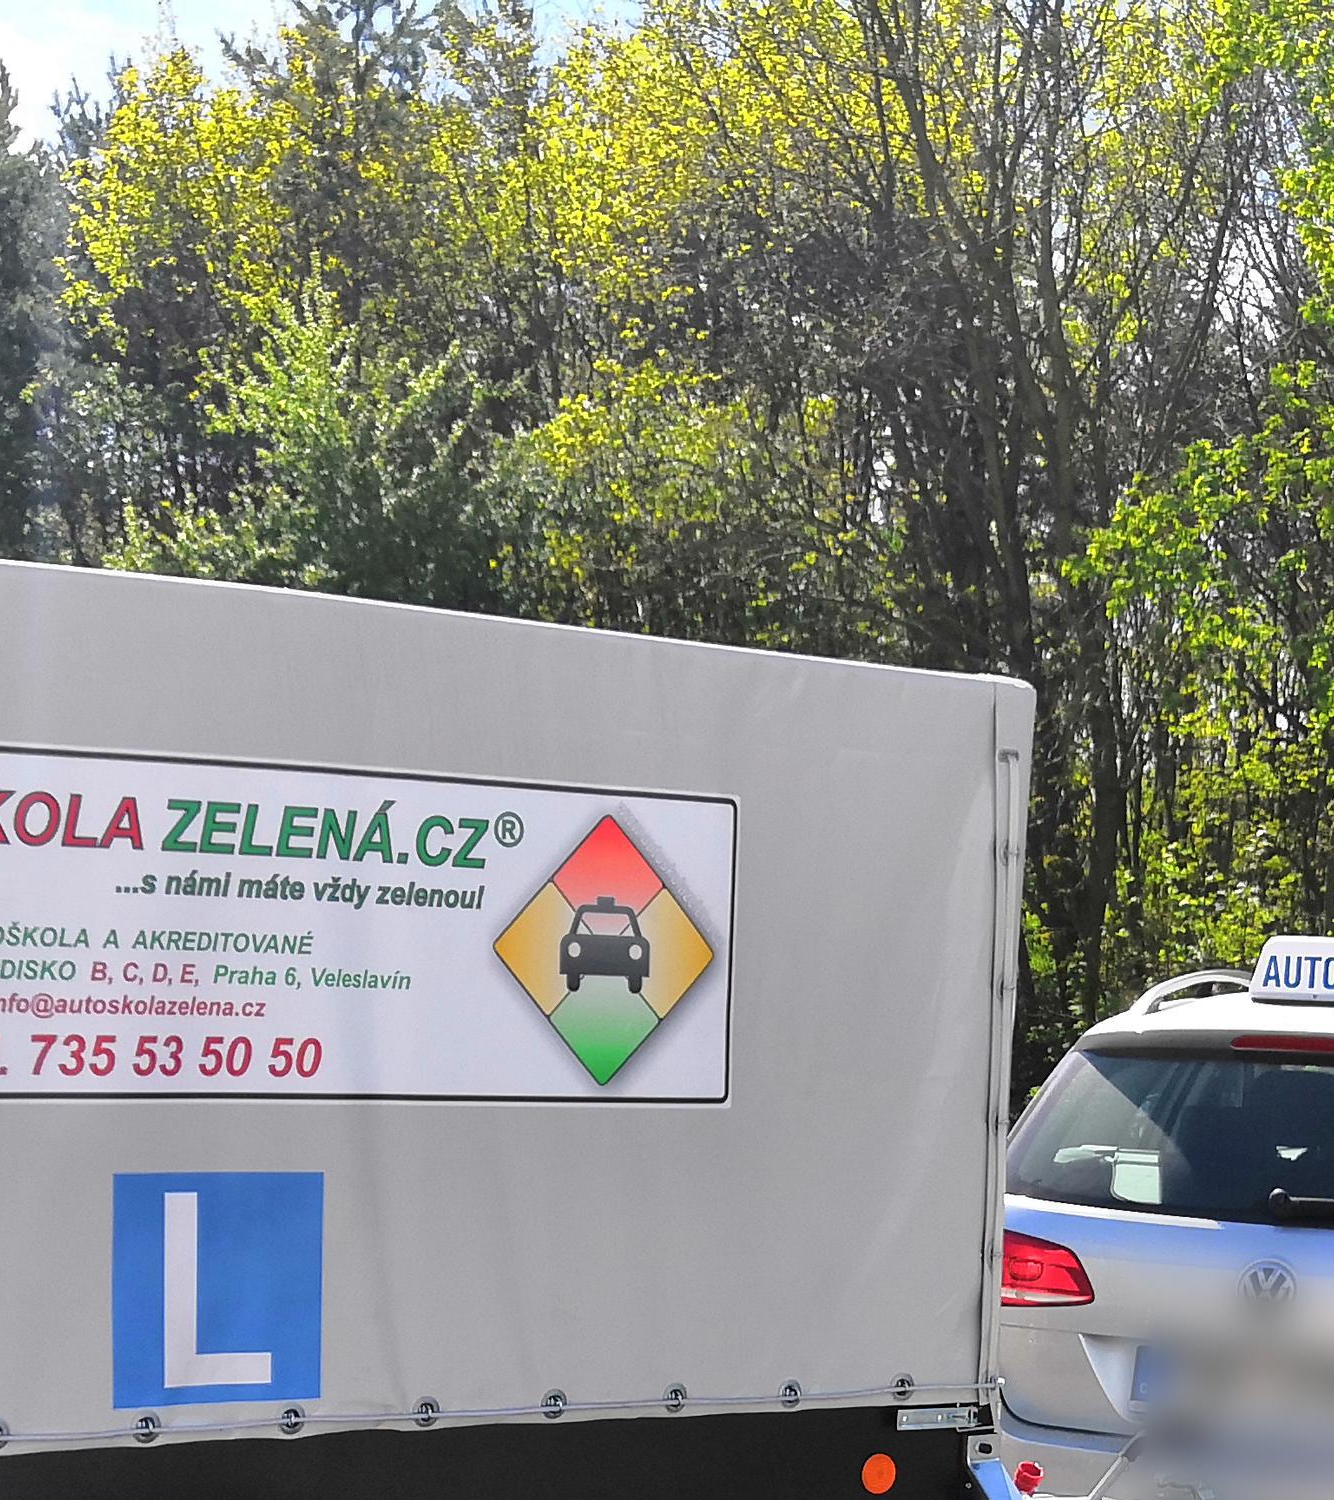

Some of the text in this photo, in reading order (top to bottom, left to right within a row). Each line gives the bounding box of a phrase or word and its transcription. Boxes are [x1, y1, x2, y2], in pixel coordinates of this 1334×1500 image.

[165, 870, 231, 898] námi
[238, 873, 305, 900] máte
[313, 876, 370, 909] vždy
[102, 928, 120, 949] A
[132, 930, 315, 955] AKREDITOVANÉ
[91, 961, 113, 985] B,
[123, 962, 144, 986] C,
[152, 963, 173, 986] D,
[180, 964, 200, 987] E,
[213, 964, 277, 986] Praha
[284, 967, 302, 989] 6,
[311, 967, 411, 990] Veleslavín
[30, 1034, 117, 1077] 735
[132, 1035, 184, 1077] 53
[198, 1036, 252, 1077] 50
[268, 1037, 323, 1078] 50
[164, 1191, 272, 1389] L
